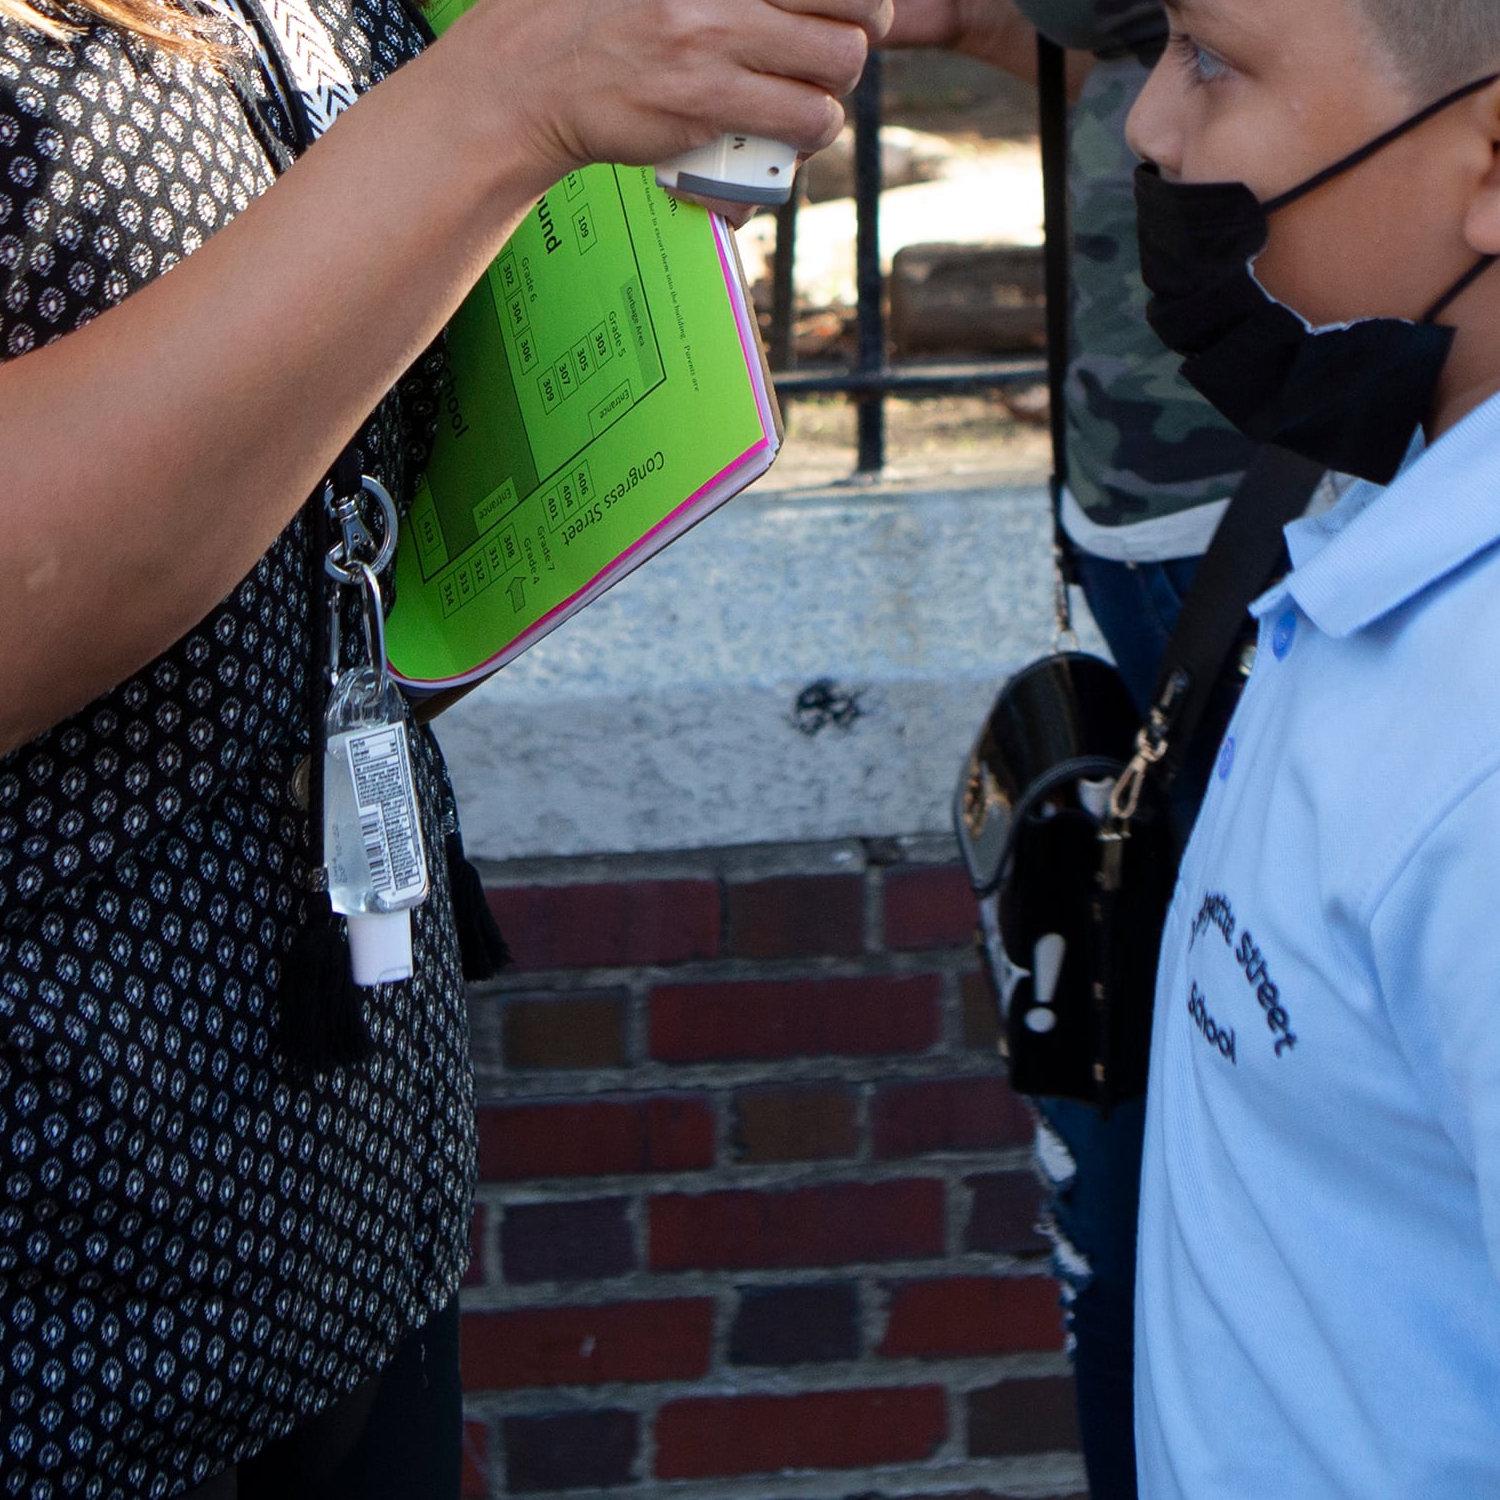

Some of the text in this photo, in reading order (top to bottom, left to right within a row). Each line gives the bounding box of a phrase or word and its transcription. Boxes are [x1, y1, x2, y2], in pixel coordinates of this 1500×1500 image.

[578, 215, 589, 239] 109
[521, 256, 538, 303] Grade 6
[503, 263, 532, 363] 302 304 306
[626, 286, 645, 347] Garbage Area
[595, 331, 606, 357] 303
[608, 310, 627, 358] Grade 5
[576, 347, 589, 372] 305
[683, 344, 696, 377] Parents
[691, 376, 700, 393] are
[559, 362, 571, 386] 307
[543, 378, 554, 402] 309
[599, 389, 630, 419] Entrance
[577, 471, 589, 496] 406
[478, 486, 513, 521] Entrance
[561, 451, 665, 546] Congress Street
[563, 484, 574, 509] 404
[547, 497, 559, 522] 401
[423, 520, 434, 544] 413
[489, 546, 501, 571] 311
[503, 534, 515, 559] 308
[536, 525, 556, 571] Grade 7
[474, 558, 486, 583] 312
[523, 537, 541, 585] Grade 4
[443, 584, 454, 607] 314
[459, 571, 470, 596] 313
[1235, 930, 1298, 1058] Street
